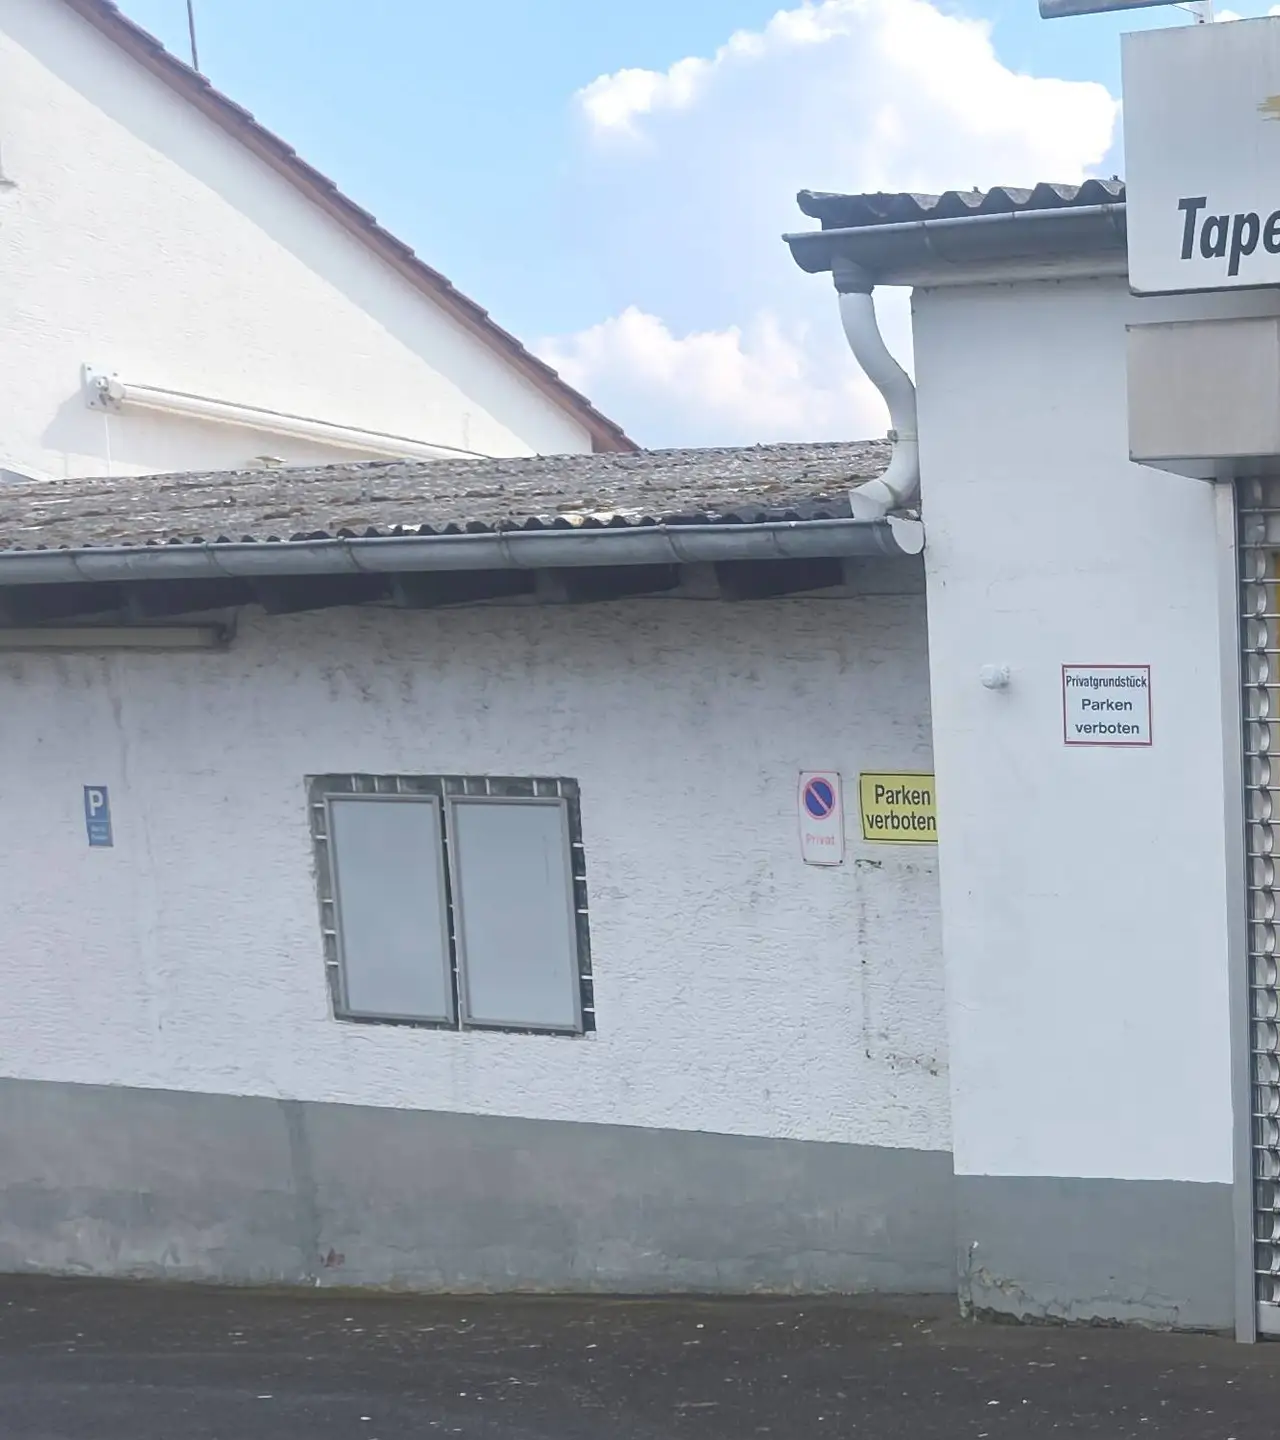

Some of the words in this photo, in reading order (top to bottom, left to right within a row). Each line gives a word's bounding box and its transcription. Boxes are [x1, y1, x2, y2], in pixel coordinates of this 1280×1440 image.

[1066, 675, 1147, 690] Privatgrundstück
[1081, 698, 1133, 711] Parken
[1075, 722, 1140, 734] verboten
[875, 784, 931, 806] Parken
[88, 789, 104, 817] P
[866, 810, 937, 831] verboten
[806, 833, 835, 846] Privat
